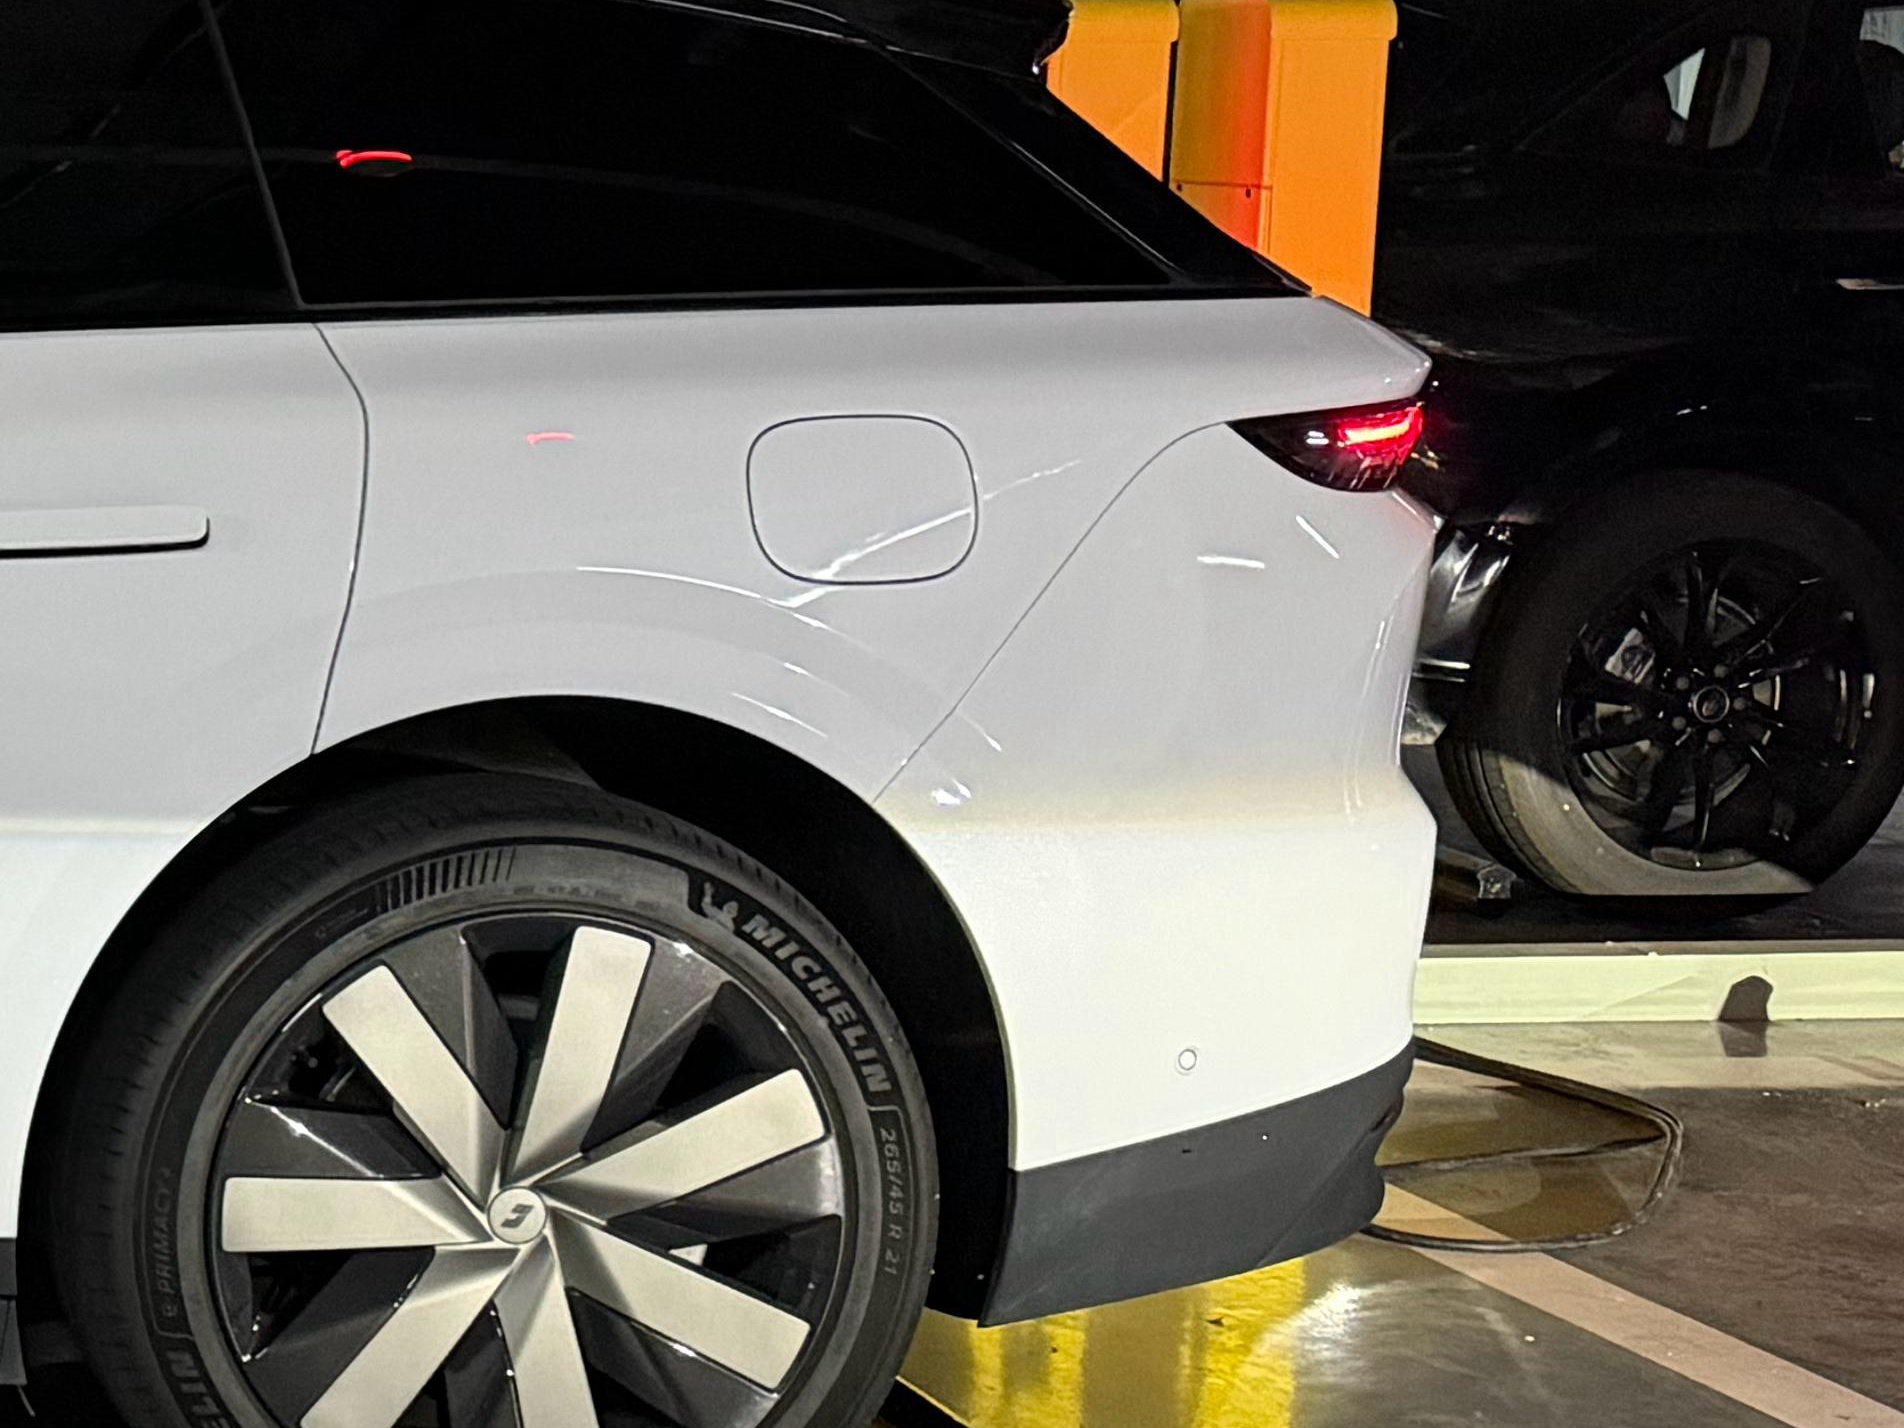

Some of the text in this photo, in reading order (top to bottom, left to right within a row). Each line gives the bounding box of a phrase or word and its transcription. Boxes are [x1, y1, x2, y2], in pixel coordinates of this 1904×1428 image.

[741, 913, 893, 1093] MICHELIN
[879, 1127, 905, 1275] 265/45 R 21
